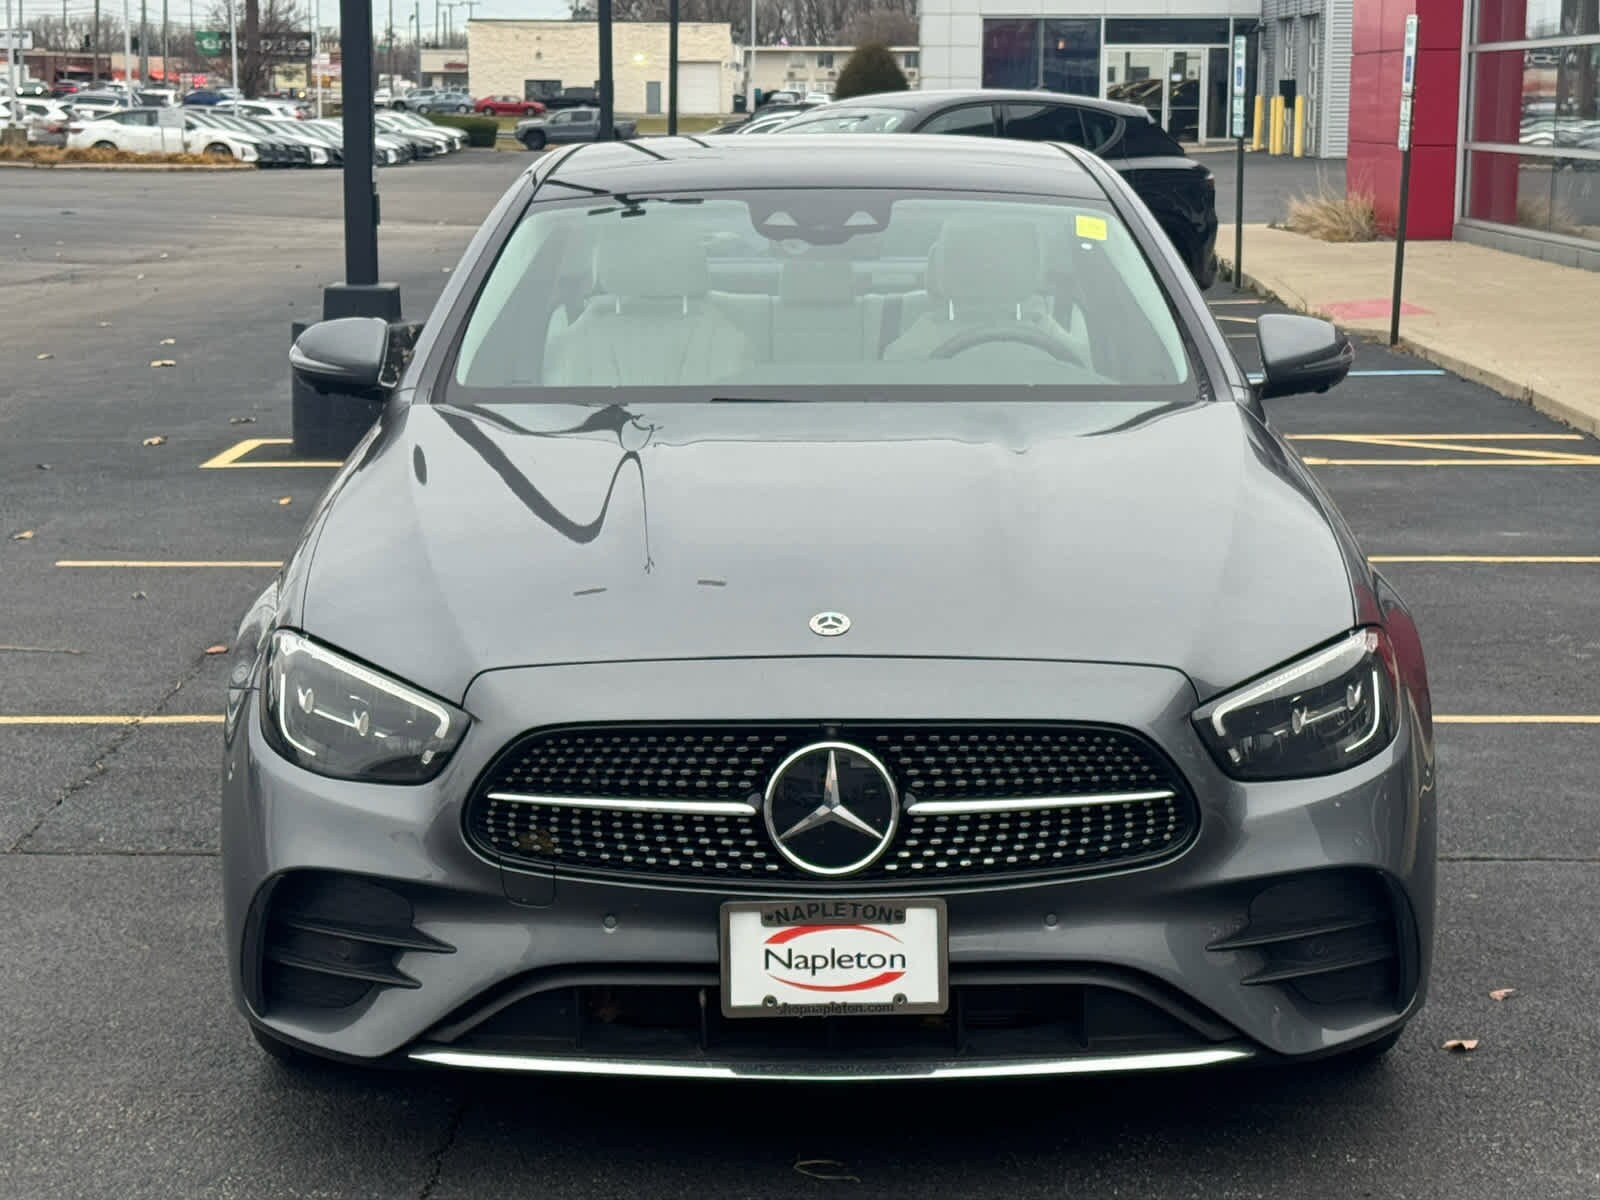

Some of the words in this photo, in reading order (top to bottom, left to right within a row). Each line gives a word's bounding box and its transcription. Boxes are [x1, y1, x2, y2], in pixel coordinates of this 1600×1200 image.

[774, 901, 893, 922] NAPLETON
[764, 948, 906, 976] Napleton
[776, 1001, 895, 1017] shopnapleton.com
